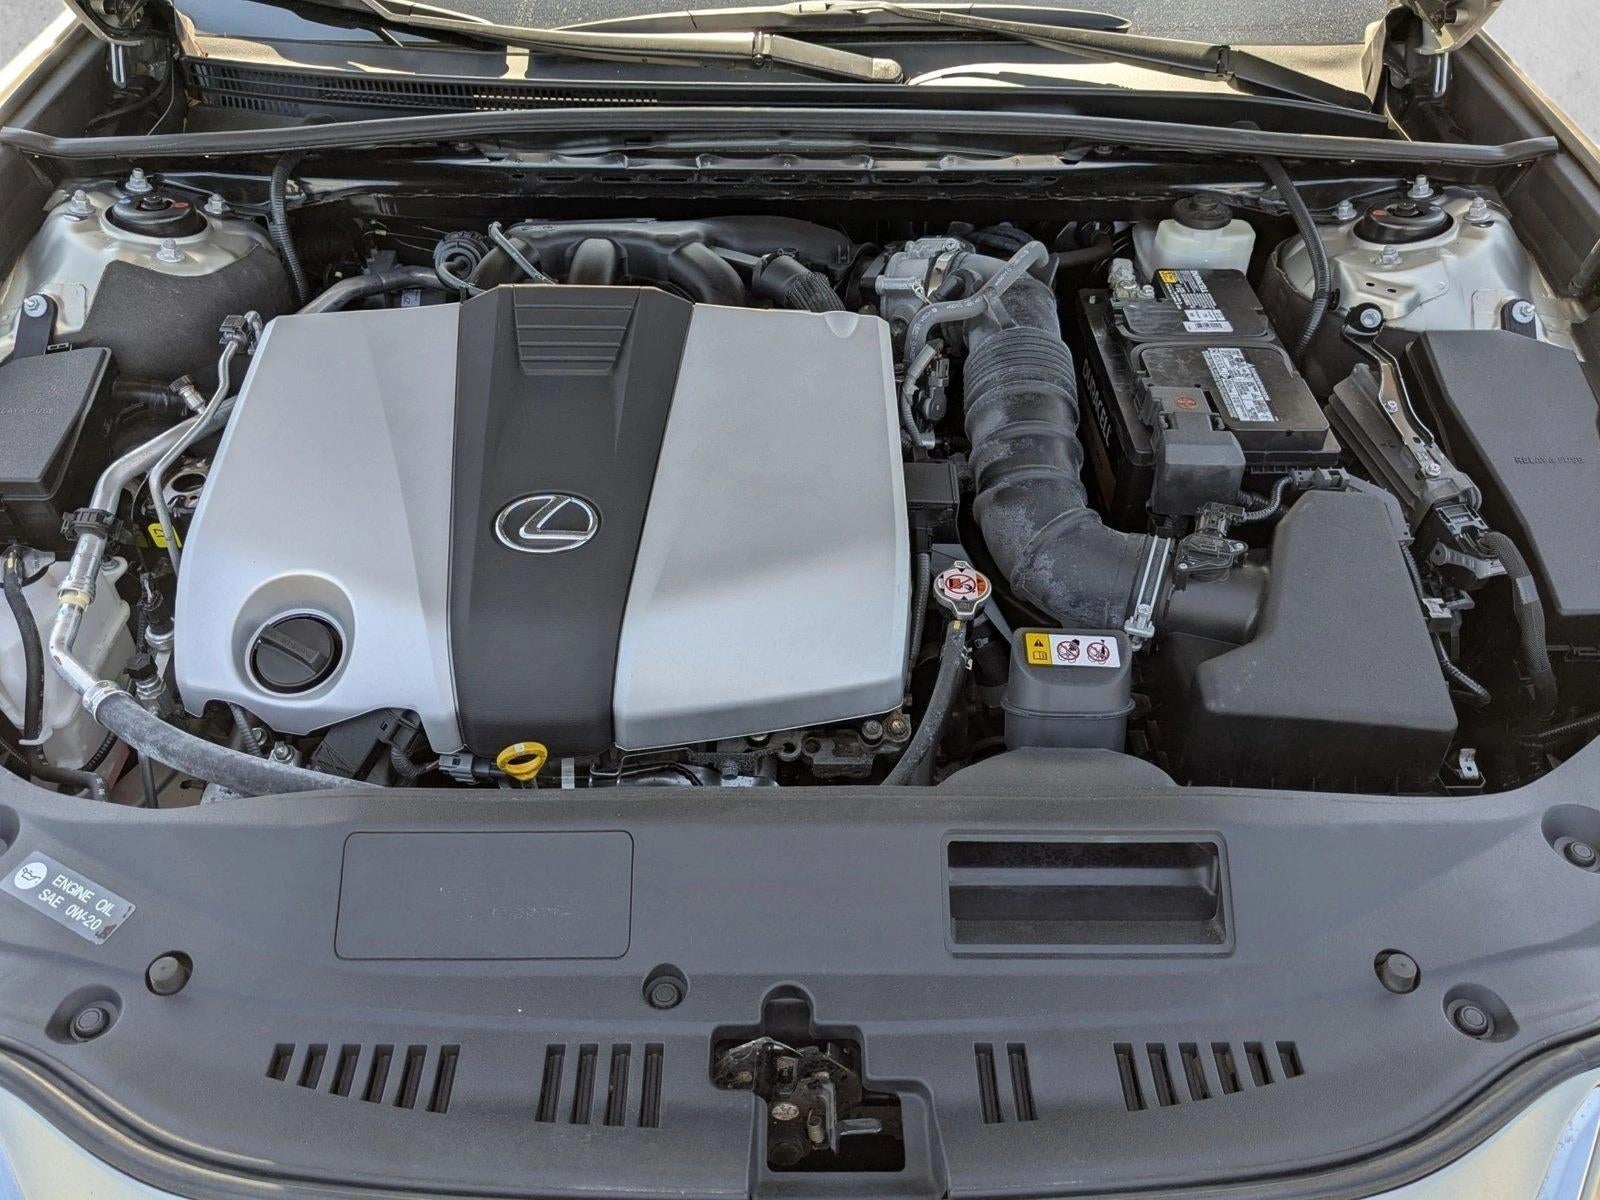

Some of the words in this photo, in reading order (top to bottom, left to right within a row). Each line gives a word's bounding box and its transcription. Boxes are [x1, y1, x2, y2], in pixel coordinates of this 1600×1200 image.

[1083, 358, 1111, 447] DURACELL
[1513, 456, 1547, 465] RELAY
[1556, 455, 1585, 464] FUSE
[38, 888, 65, 908] SAE
[65, 904, 103, 931] 0W-20
[52, 874, 95, 903] ENGINE
[95, 899, 116, 917] OIL
